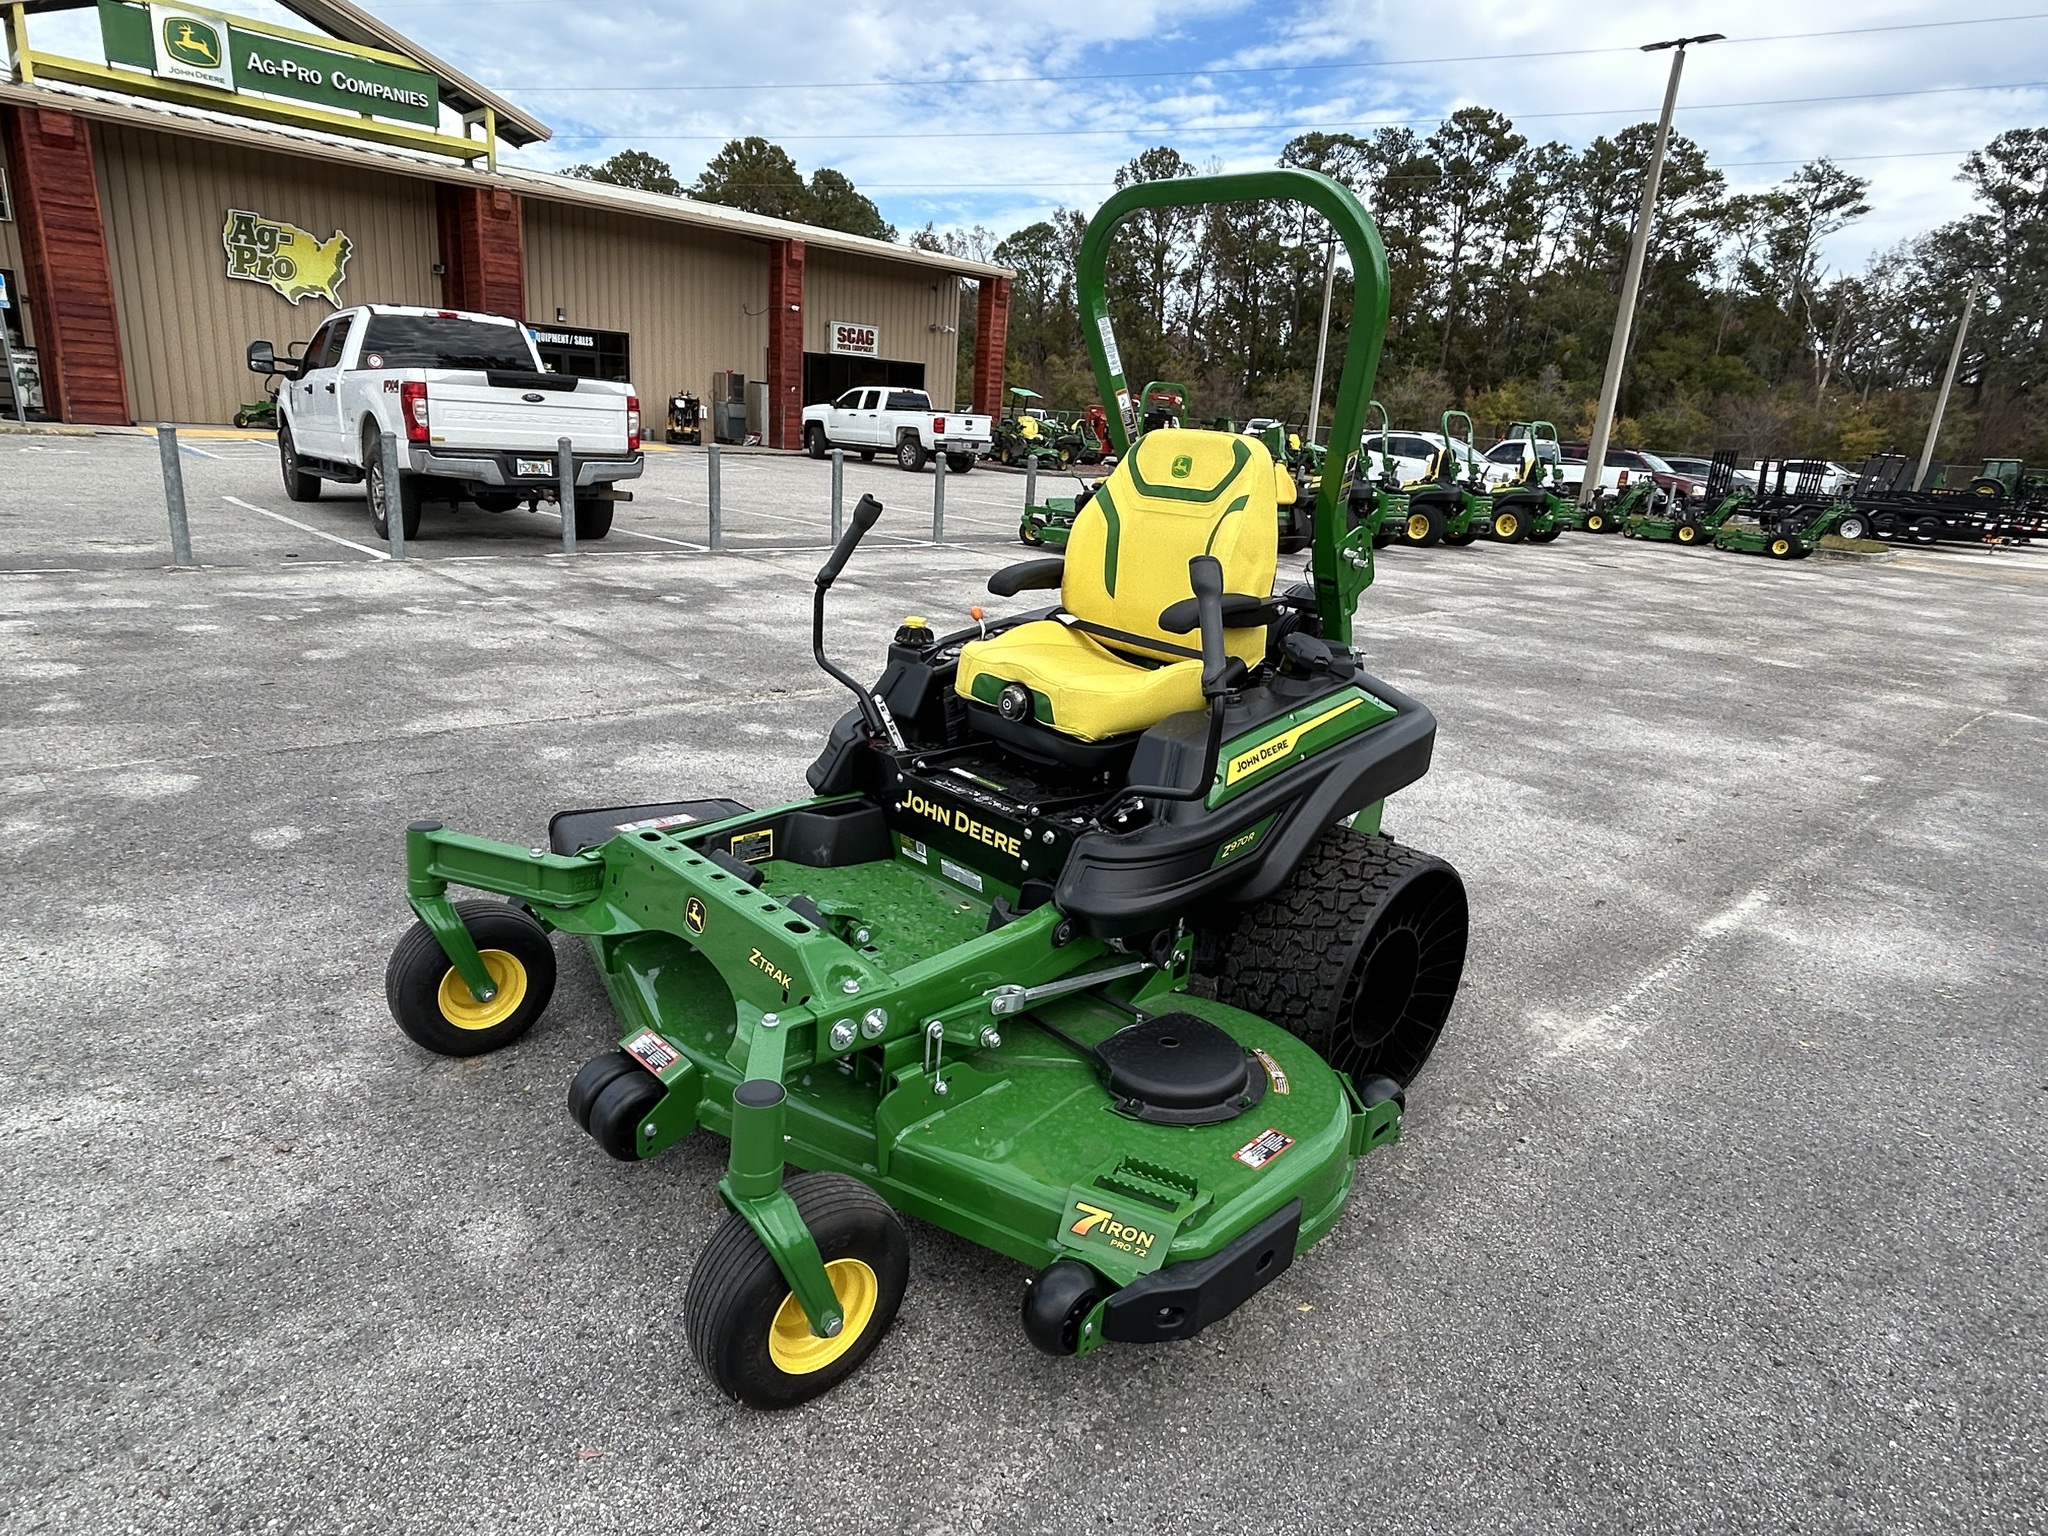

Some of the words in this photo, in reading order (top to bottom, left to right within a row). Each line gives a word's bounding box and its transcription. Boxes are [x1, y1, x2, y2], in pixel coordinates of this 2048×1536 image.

[168, 66, 195, 78] JOHN
[195, 70, 226, 85] DEERE
[330, 70, 430, 108] COMPANIES
[229, 213, 293, 254] Ag-
[231, 245, 297, 281] Pro
[535, 331, 570, 345] QUIPMENT
[574, 335, 594, 347] SALES
[837, 326, 875, 346] SCAG
[1237, 753, 1260, 773] JOHN
[1260, 739, 1289, 760] DEERE
[902, 790, 951, 826] JOHN
[954, 810, 1022, 858] DEERE
[1221, 831, 1256, 858] Z970R
[748, 947, 793, 990] ZTRAK
[1110, 1239, 1132, 1253] PRO
[1134, 1247, 1147, 1258] 72
